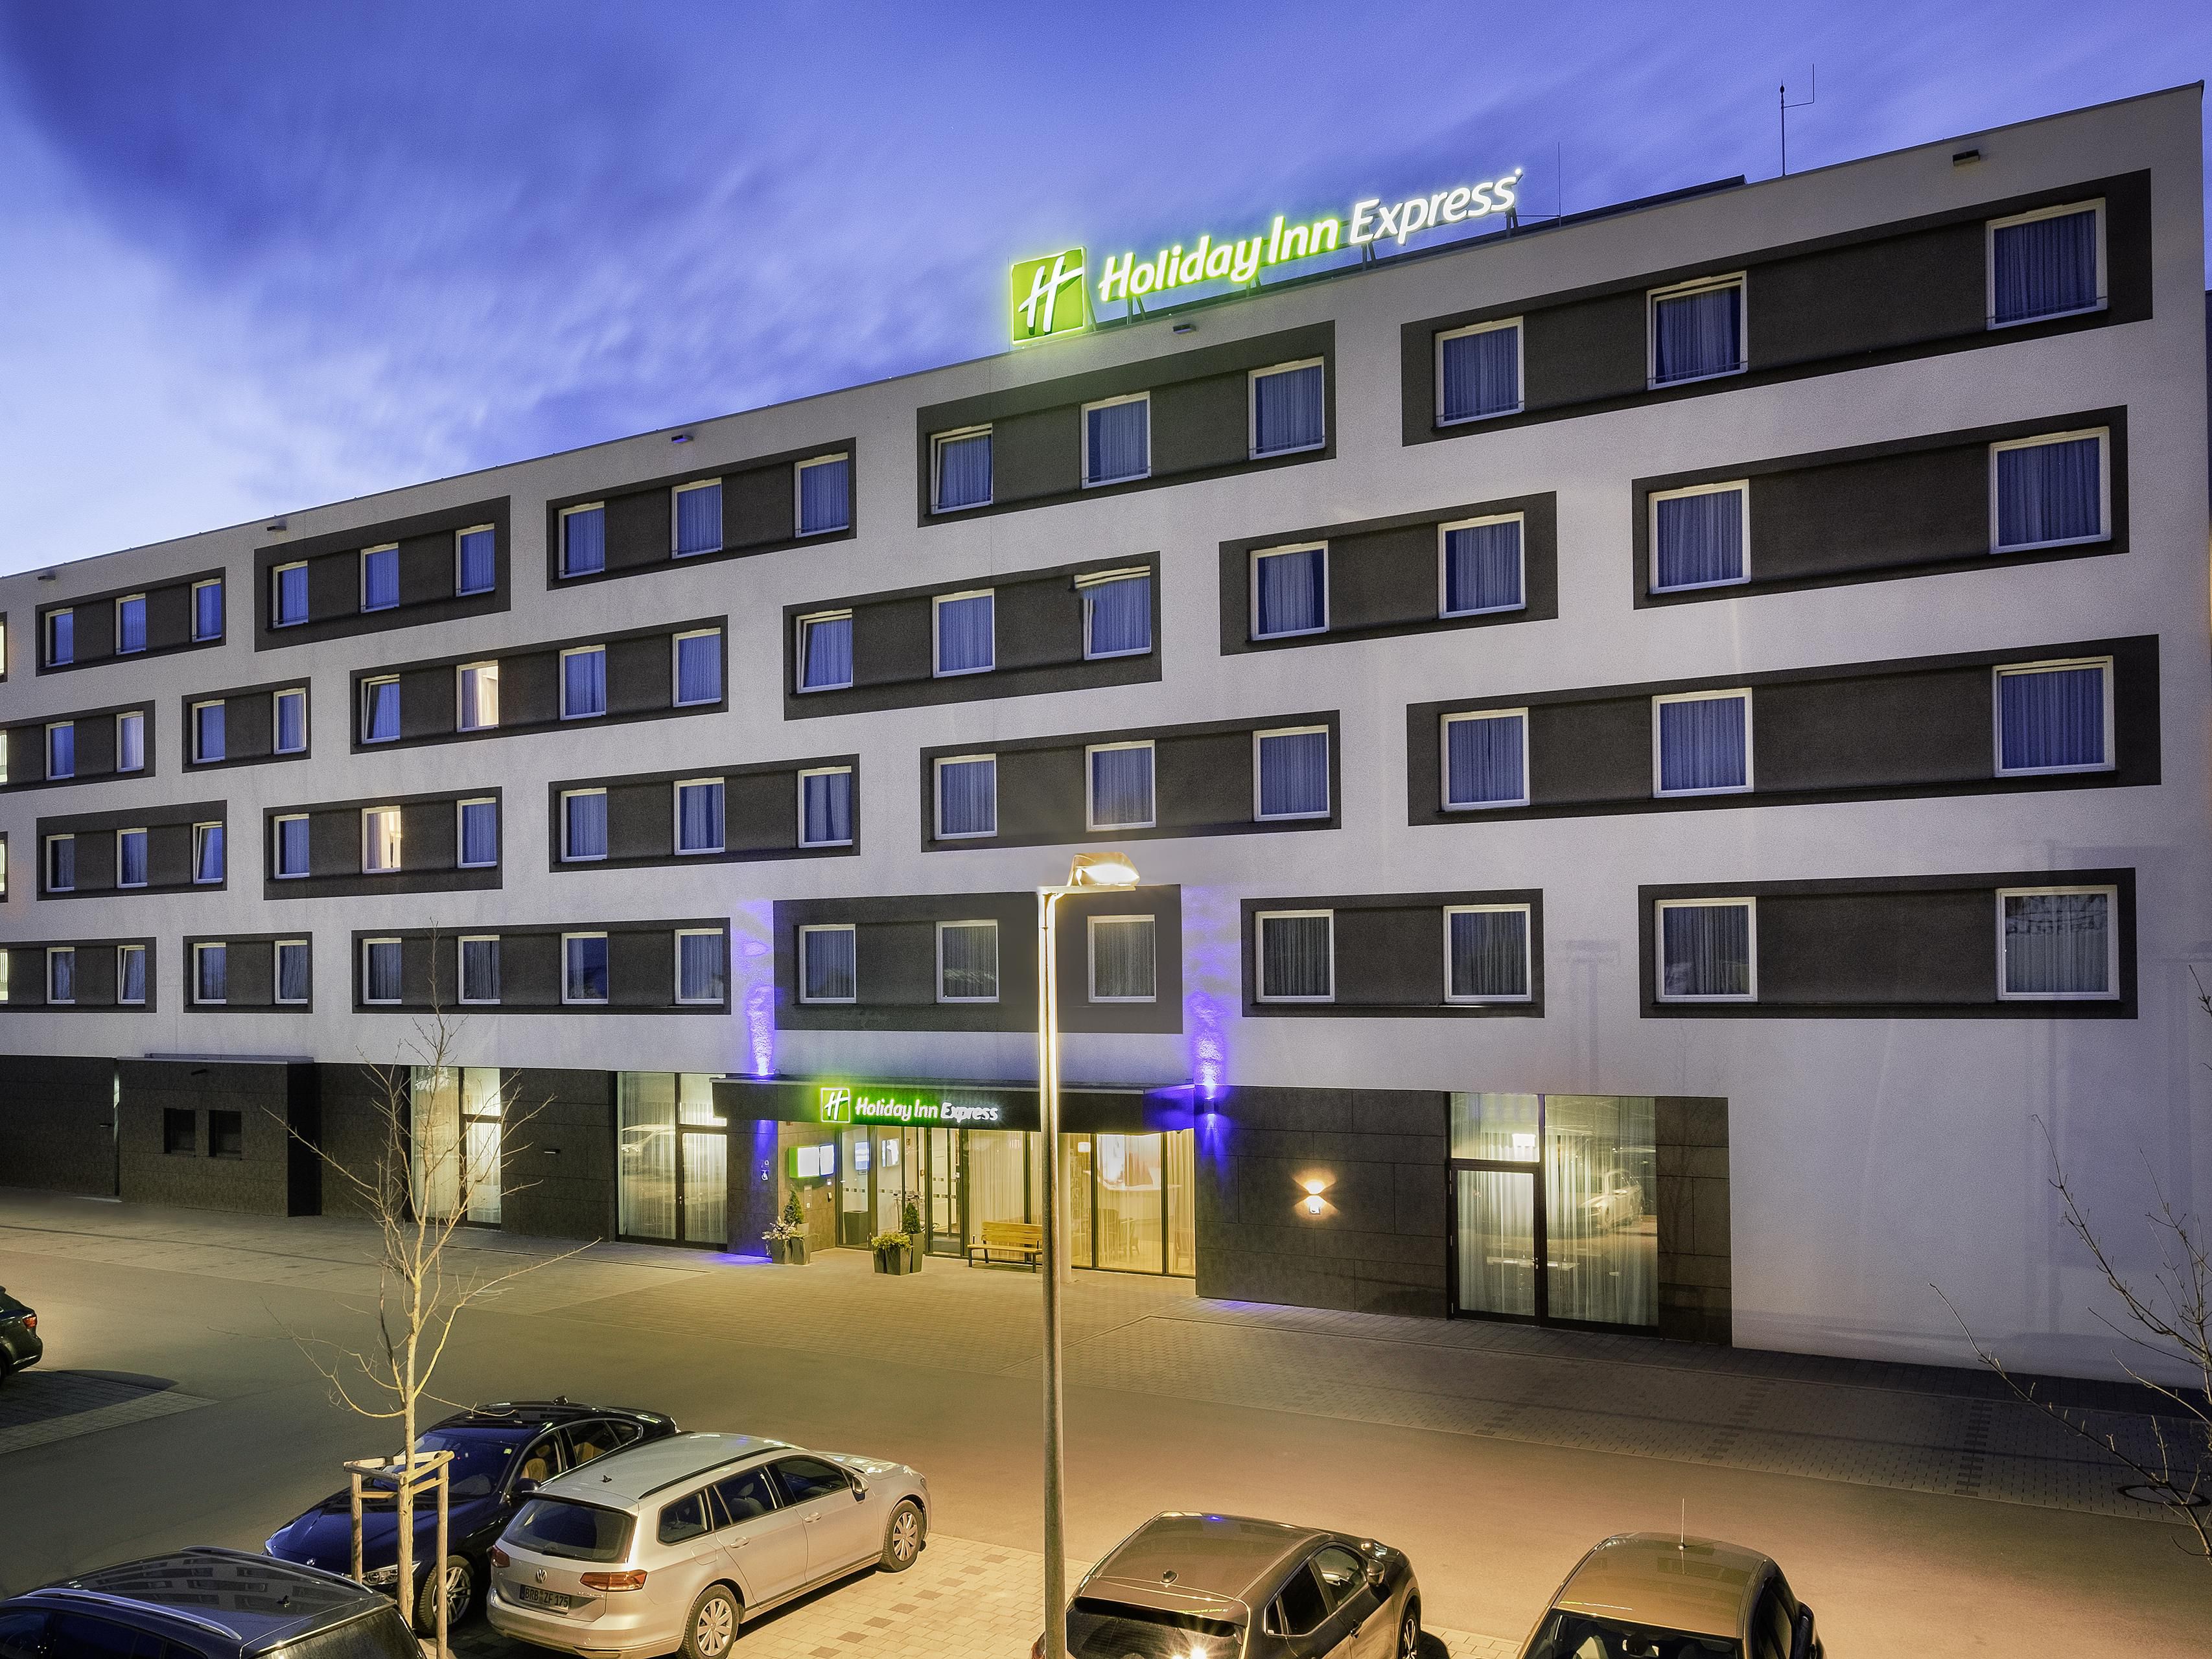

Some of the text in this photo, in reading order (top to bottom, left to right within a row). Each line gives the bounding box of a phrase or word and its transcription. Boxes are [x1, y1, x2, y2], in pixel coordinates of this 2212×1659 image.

[1098, 176, 1517, 301] Holiday Inn Express
[855, 1096, 999, 1123] Holiday Inn Express
[525, 1588, 539, 1601] BRB
[544, 1592, 553, 1604] ZF
